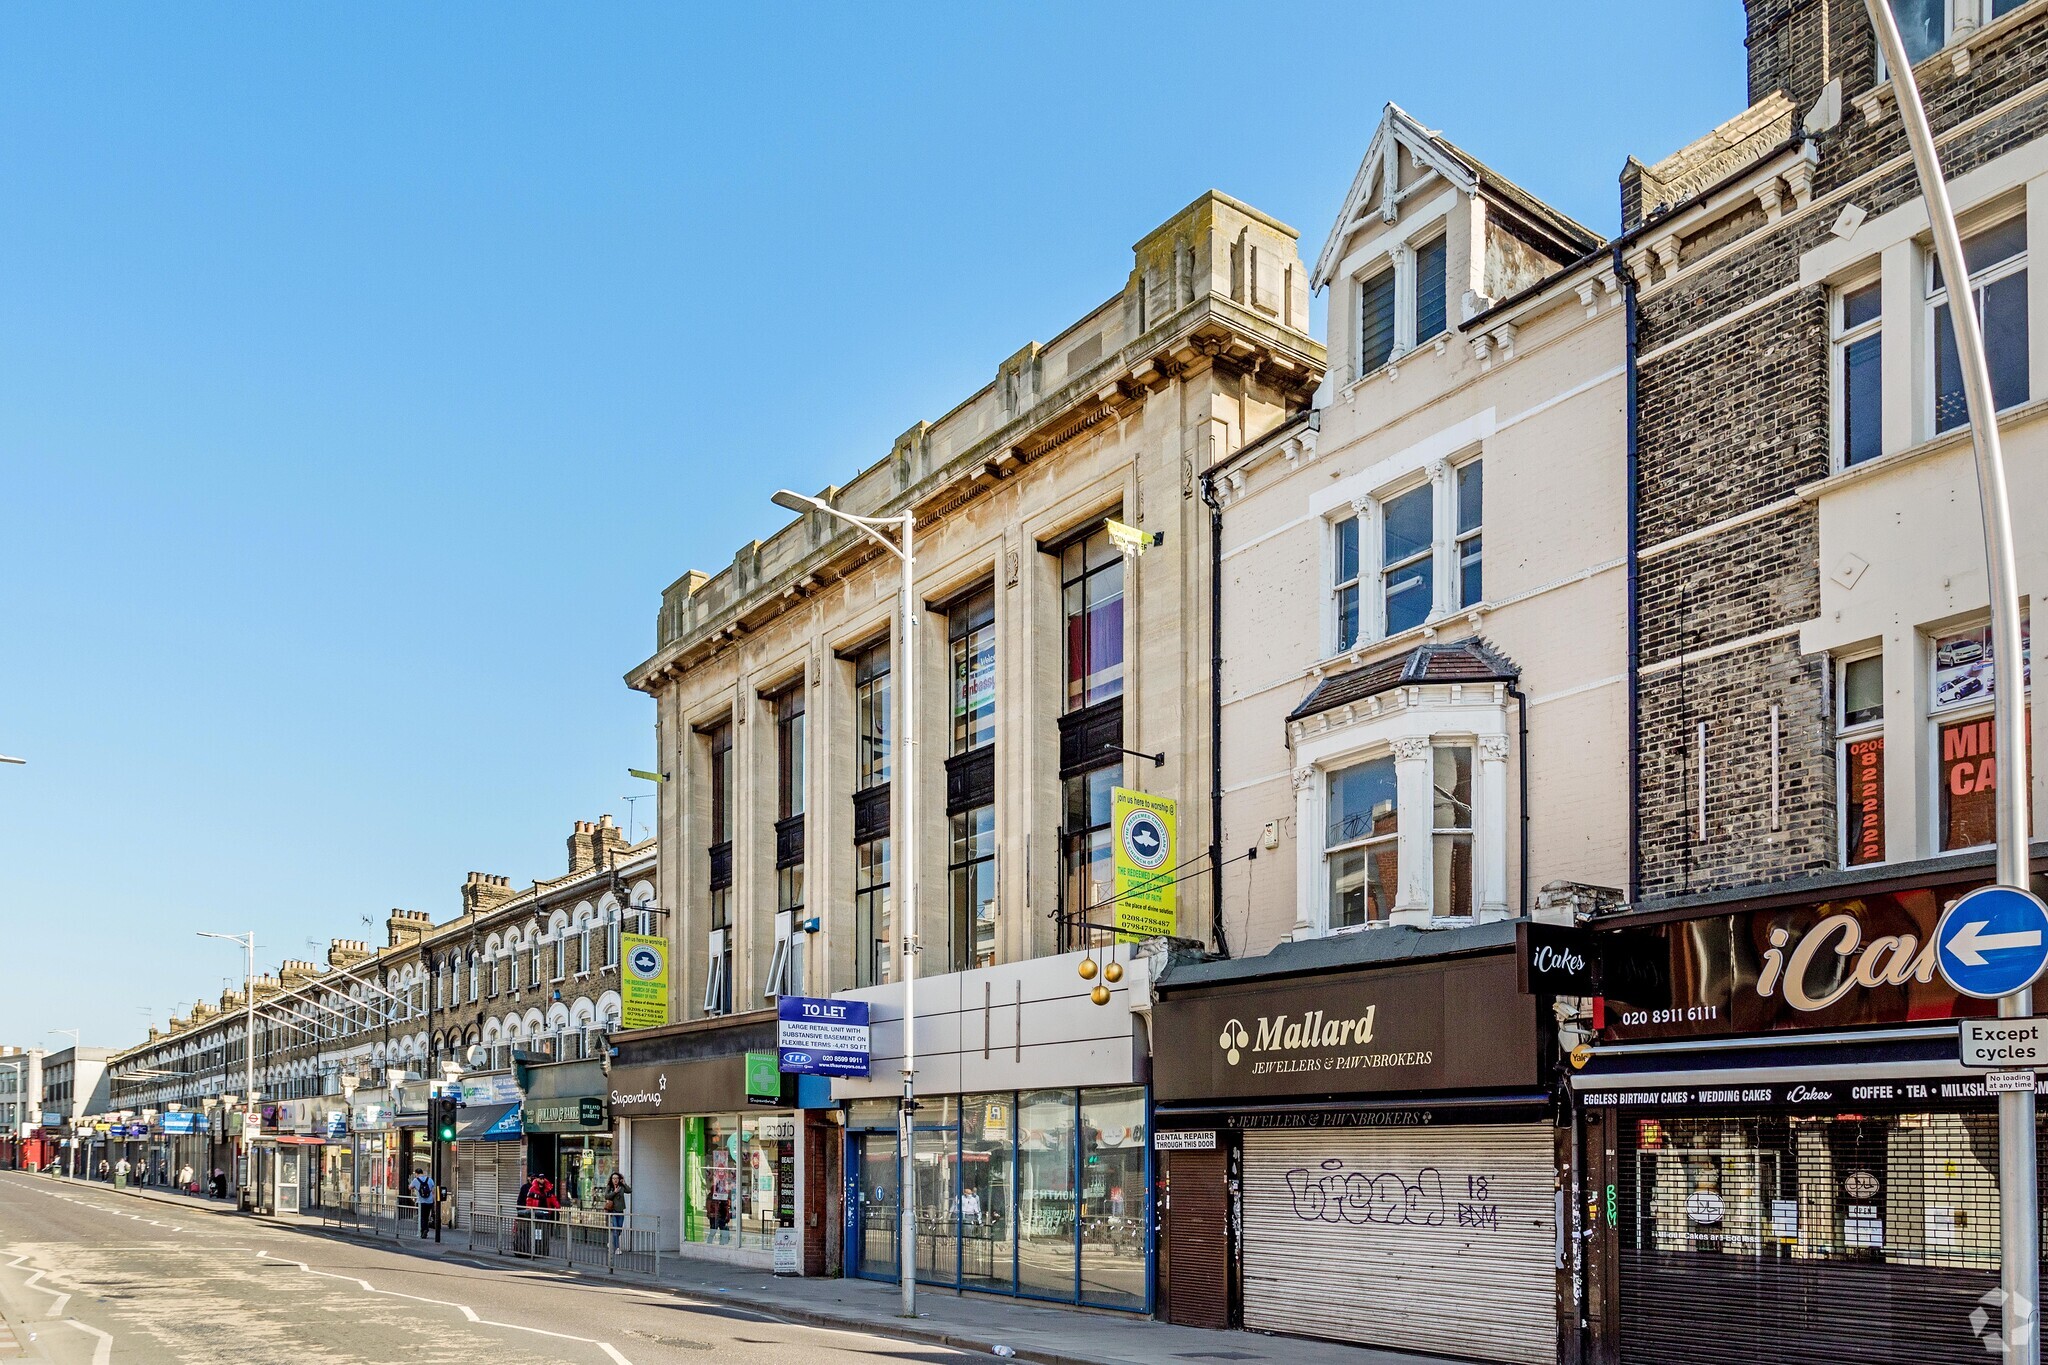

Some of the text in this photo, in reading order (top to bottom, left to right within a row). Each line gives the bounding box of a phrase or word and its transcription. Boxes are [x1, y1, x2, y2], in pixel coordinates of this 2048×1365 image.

[1850, 738, 1884, 755] 0208
[1944, 720, 1996, 761] MI
[1117, 792, 1126, 803] join
[1127, 796, 1133, 804] us
[1134, 796, 1144, 806] here
[1145, 800, 1150, 808] to
[1151, 802, 1168, 813] worship
[1118, 866, 1126, 876] THE
[1127, 868, 1150, 880] REDEEMED
[1159, 908, 1174, 916] solution
[1533, 946, 1586, 975] iCakes
[802, 1004, 846, 1018] TO LET
[1622, 1005, 1717, 1026] 020 8911 6111
[1252, 1004, 1376, 1052] Mallard
[1972, 1026, 2038, 1042] Except
[782, 1031, 823, 1040] SUBSTANSIVE
[824, 1033, 856, 1042] BASEMENT
[1572, 1052, 1588, 1062] Yale
[1976, 1046, 2036, 1061] cycles
[1252, 1051, 1433, 1074] JEWELLERS & PAWNBROKERS
[612, 1090, 662, 1107] Superdrug
[1584, 1088, 1772, 1105] EGGLESS BIRTHDAY CAKES WEDDING CAKES
[1786, 1085, 1832, 1103] iCakes
[1852, 1084, 1894, 1100] COFFEE
[1906, 1084, 1928, 1098] TEA
[564, 1106, 580, 1120] BARRE
[1237, 1112, 1420, 1128] JEWELLERS & PAWNBROKERS
[1606, 1184, 1617, 1226] BDM
[1854, 1206, 1872, 1215] OPEN
[1684, 1232, 1708, 1240] Cakes
